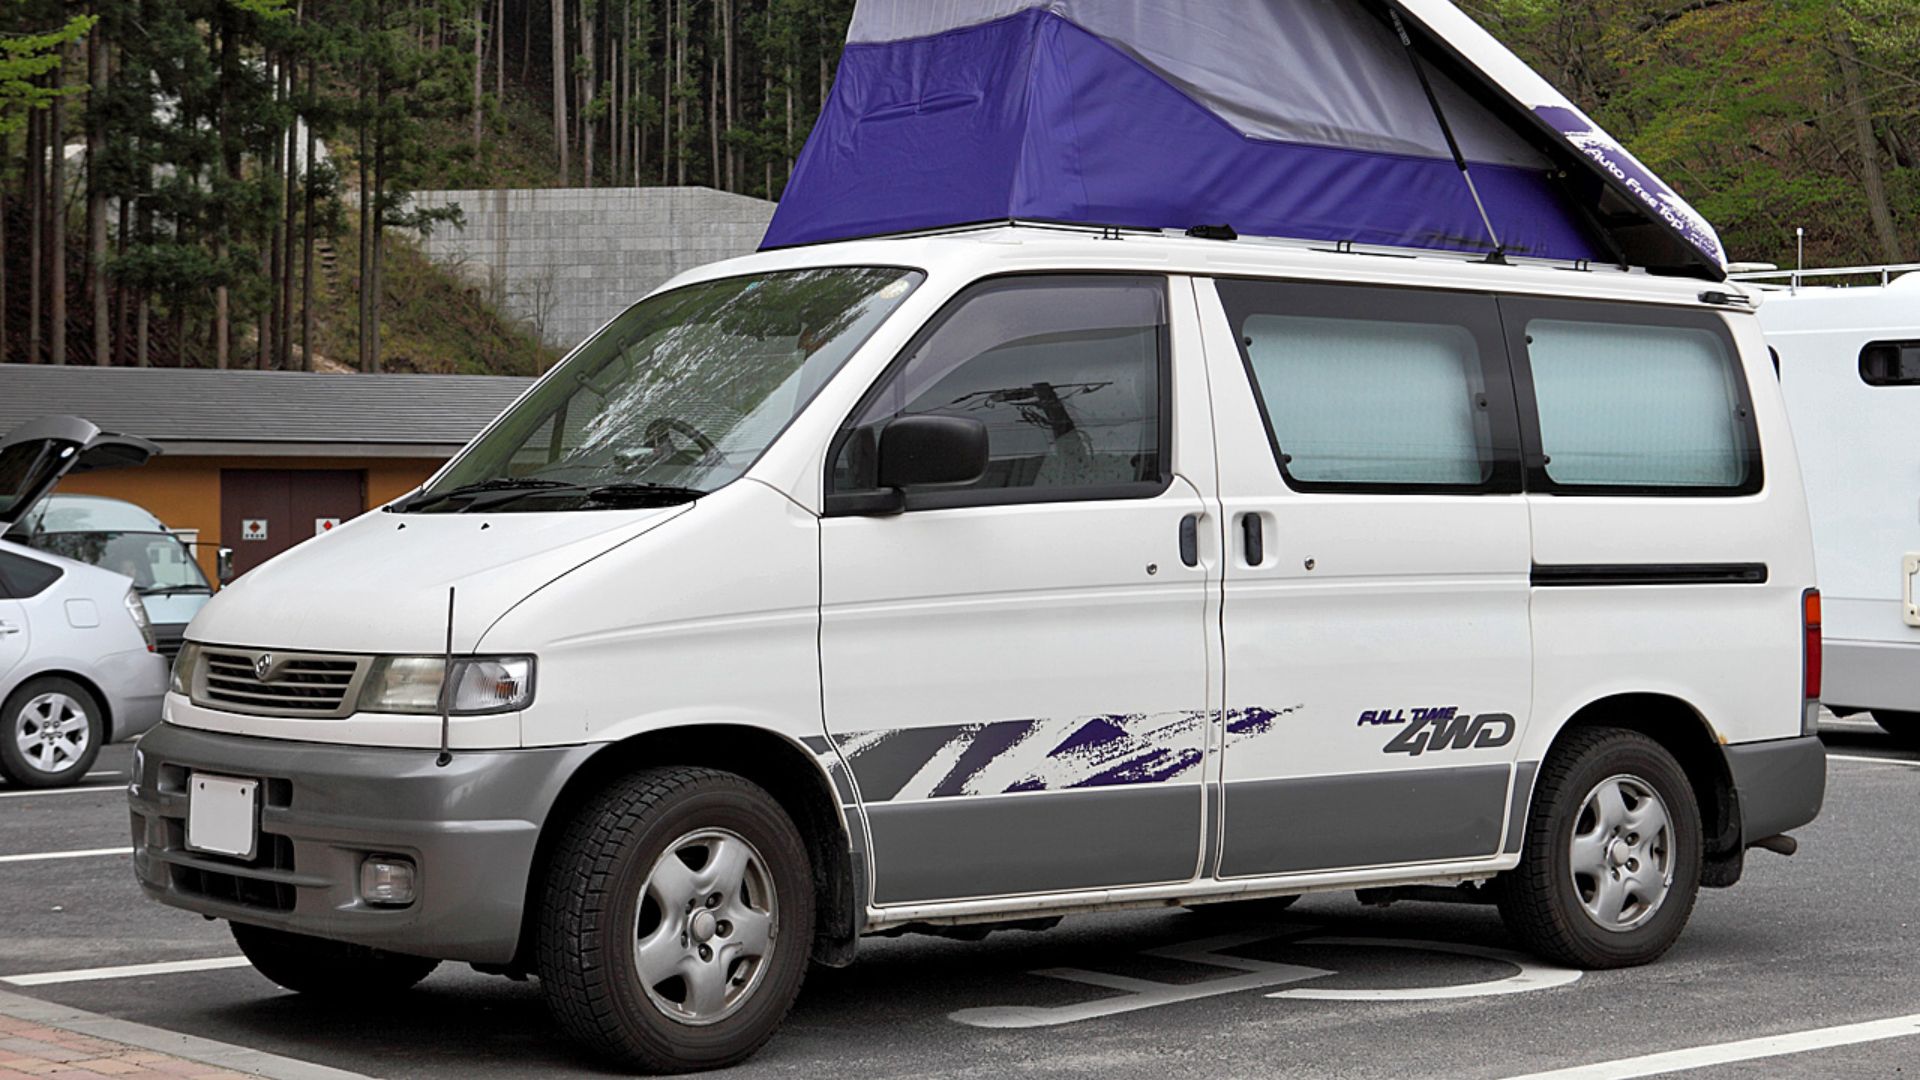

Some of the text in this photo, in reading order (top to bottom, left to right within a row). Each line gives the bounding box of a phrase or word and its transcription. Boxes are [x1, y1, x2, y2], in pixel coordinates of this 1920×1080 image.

[1586, 149, 1684, 230] Auto Free Top
[1357, 706, 1459, 726] FULL TIME
[1383, 713, 1516, 756] 4WD
